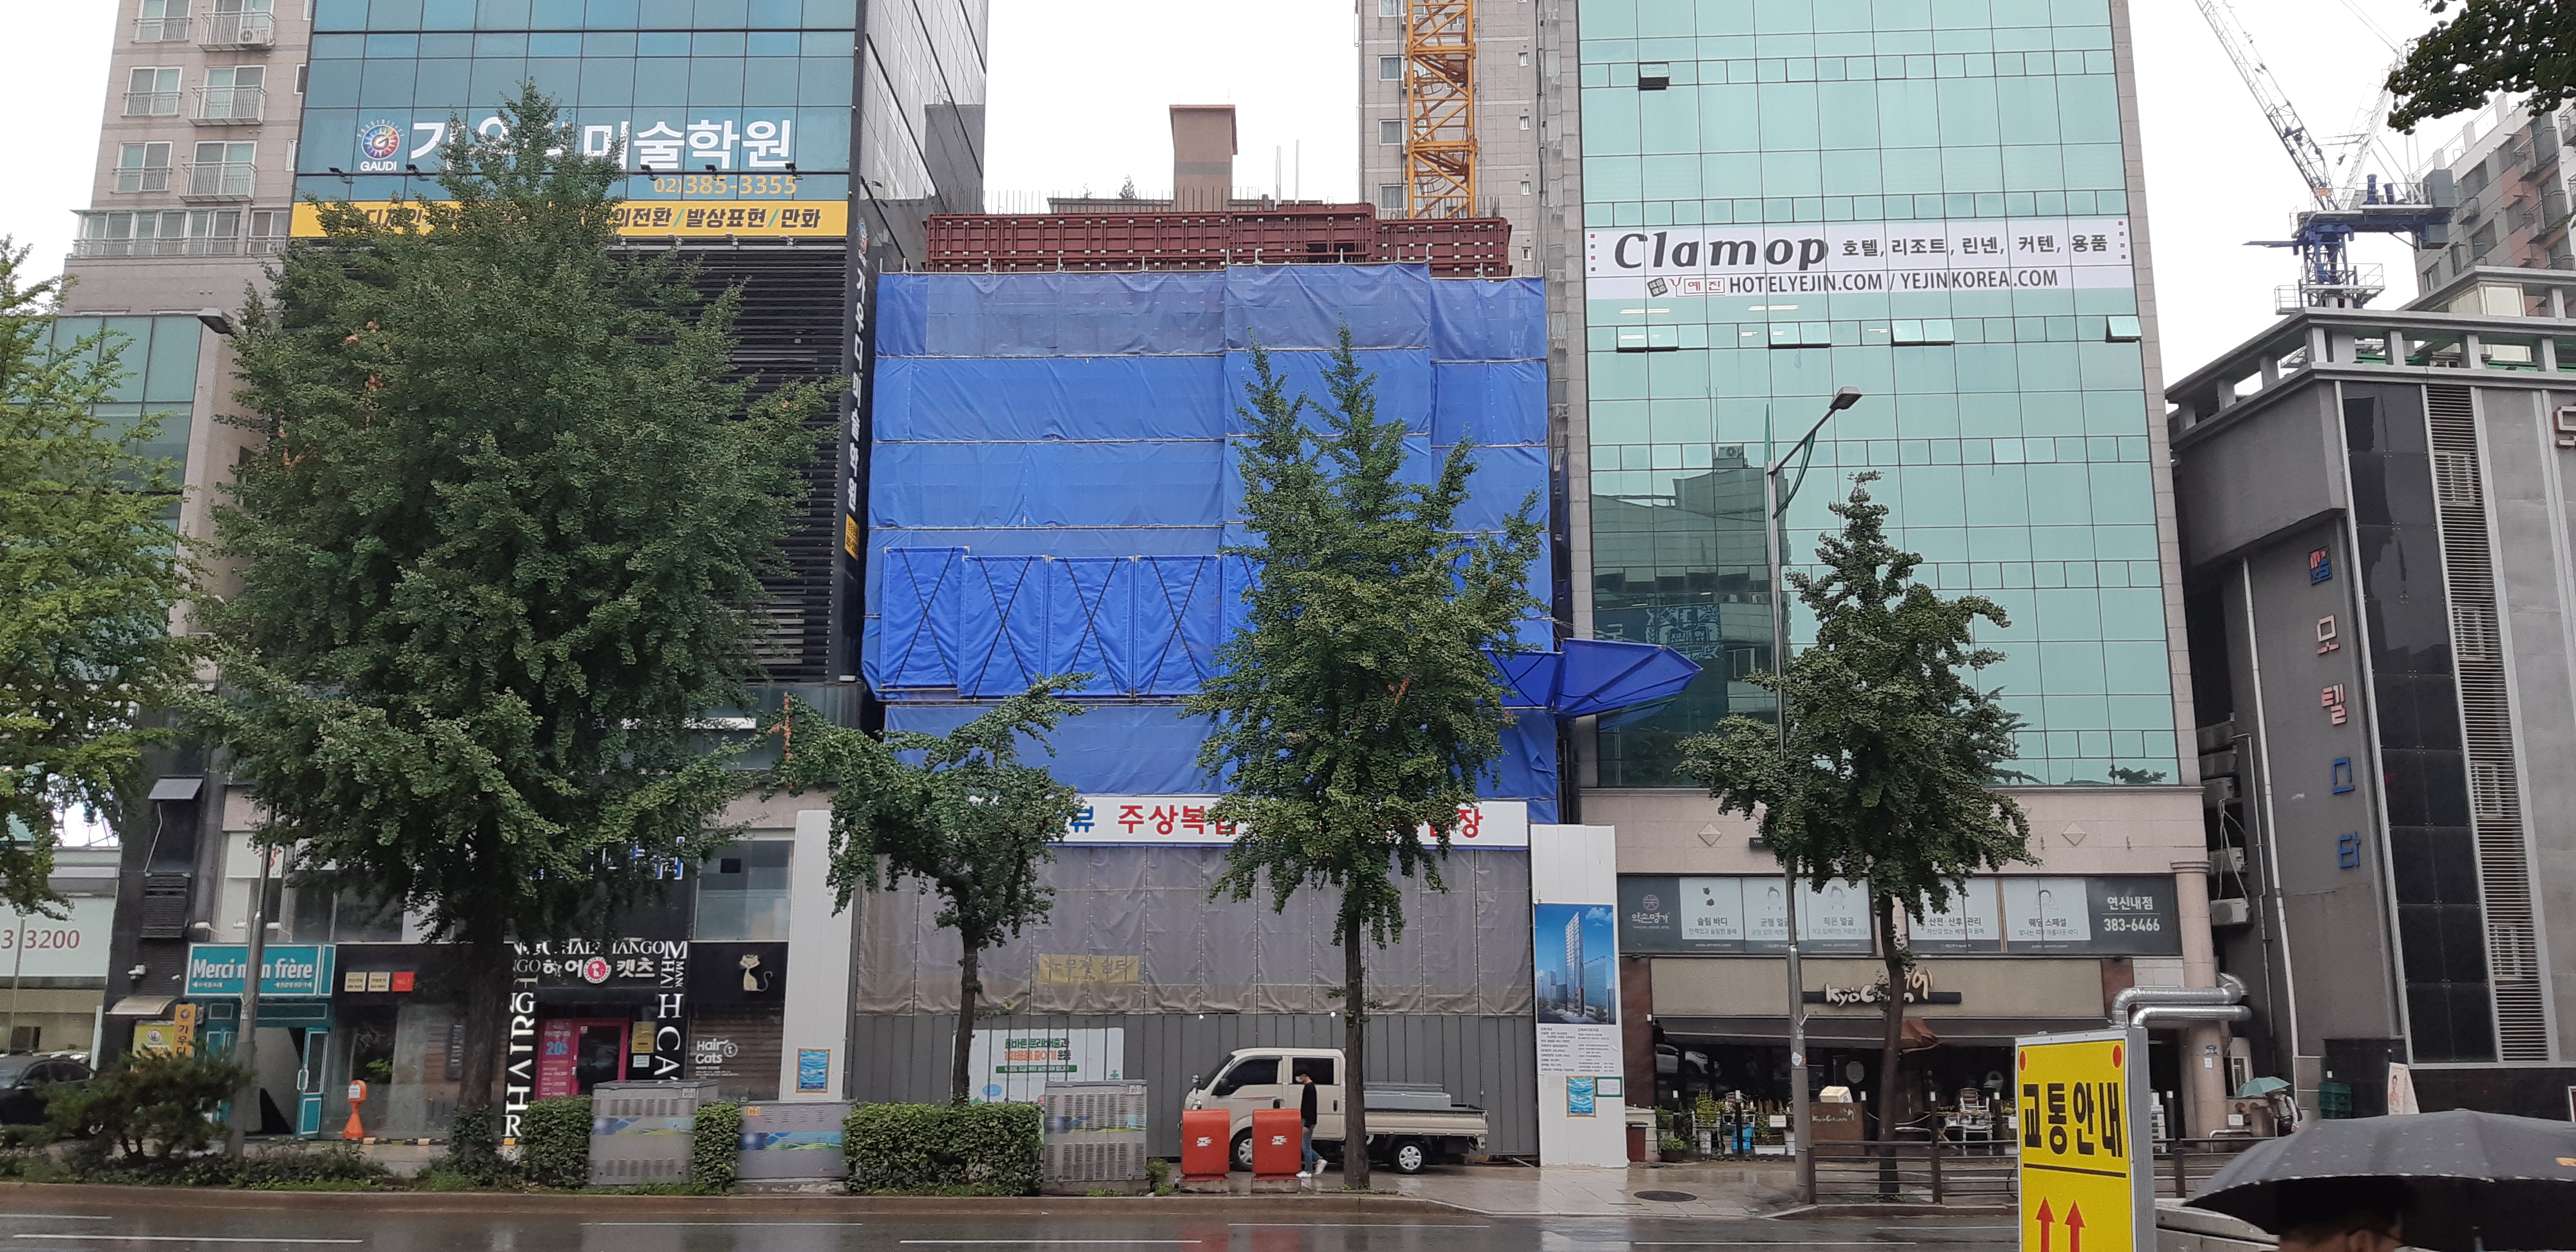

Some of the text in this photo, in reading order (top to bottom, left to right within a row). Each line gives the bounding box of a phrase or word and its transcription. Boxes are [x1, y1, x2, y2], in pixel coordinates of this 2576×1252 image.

[359, 160, 397, 172] GAUDI
[2071, 234, 2108, 253] 용품
[1614, 231, 1829, 271] Clamop
[1730, 273, 1883, 294] HOTELYEJIN.COM
[1900, 269, 2058, 290] YEJINKOREA.COM
[2107, 895, 2153, 910] 연신내점
[1632, 912, 1669, 924] 약손명가
[1713, 917, 1728, 926] 바디
[1822, 917, 1854, 926] 작은 얼굴
[1967, 917, 1982, 926] 관리
[2104, 918, 2161, 932] 383-6466
[192, 958, 234, 979] Merci
[274, 957, 313, 979] frère
[697, 1038, 729, 1051] Hair
[2023, 1082, 2123, 1158] 교통안내
